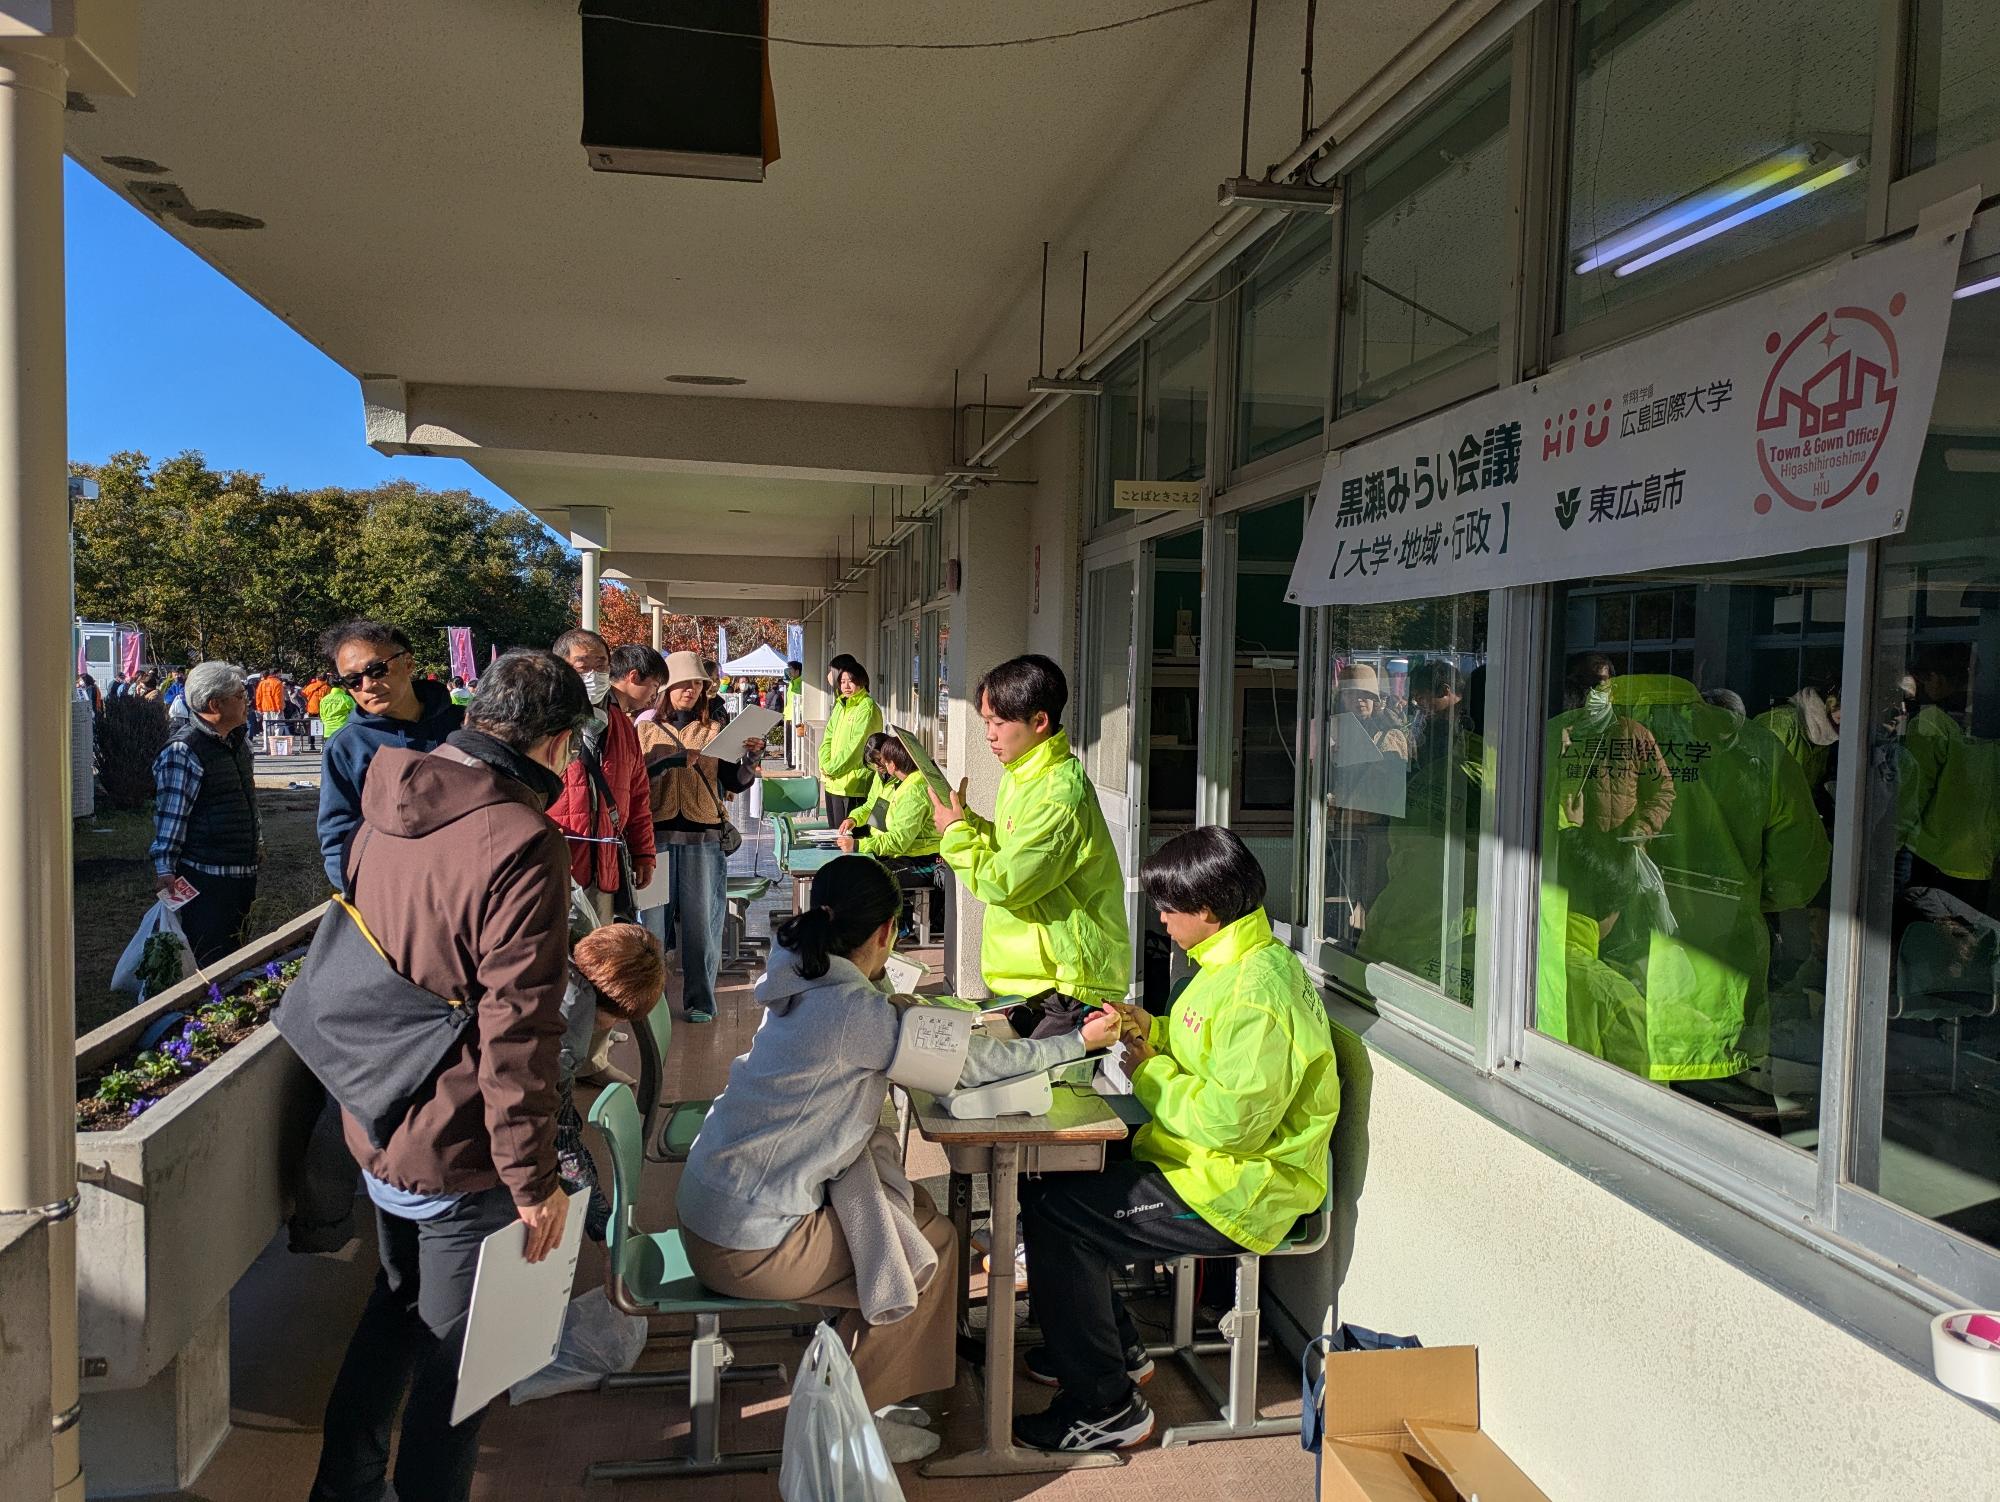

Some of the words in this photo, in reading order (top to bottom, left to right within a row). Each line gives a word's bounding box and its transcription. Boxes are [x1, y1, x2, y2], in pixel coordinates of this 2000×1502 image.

[1620, 378, 1732, 439] 広島国際大学
[1769, 445, 1800, 463] Town
[1802, 437, 1812, 456] &
[1814, 435, 1843, 455] Gown
[1846, 426, 1879, 447] Office
[1334, 421, 1522, 529] 黒瀬みらい会議
[1780, 450, 1867, 480] Higashihiroshima
[1120, 489, 1200, 503] ことばときこえ2
[1588, 468, 1686, 523] 東広島市
[1813, 480, 1830, 497] HIU
[1557, 738, 1712, 764] 広島国際大学
[1126, 1202, 1164, 1218] phiten
